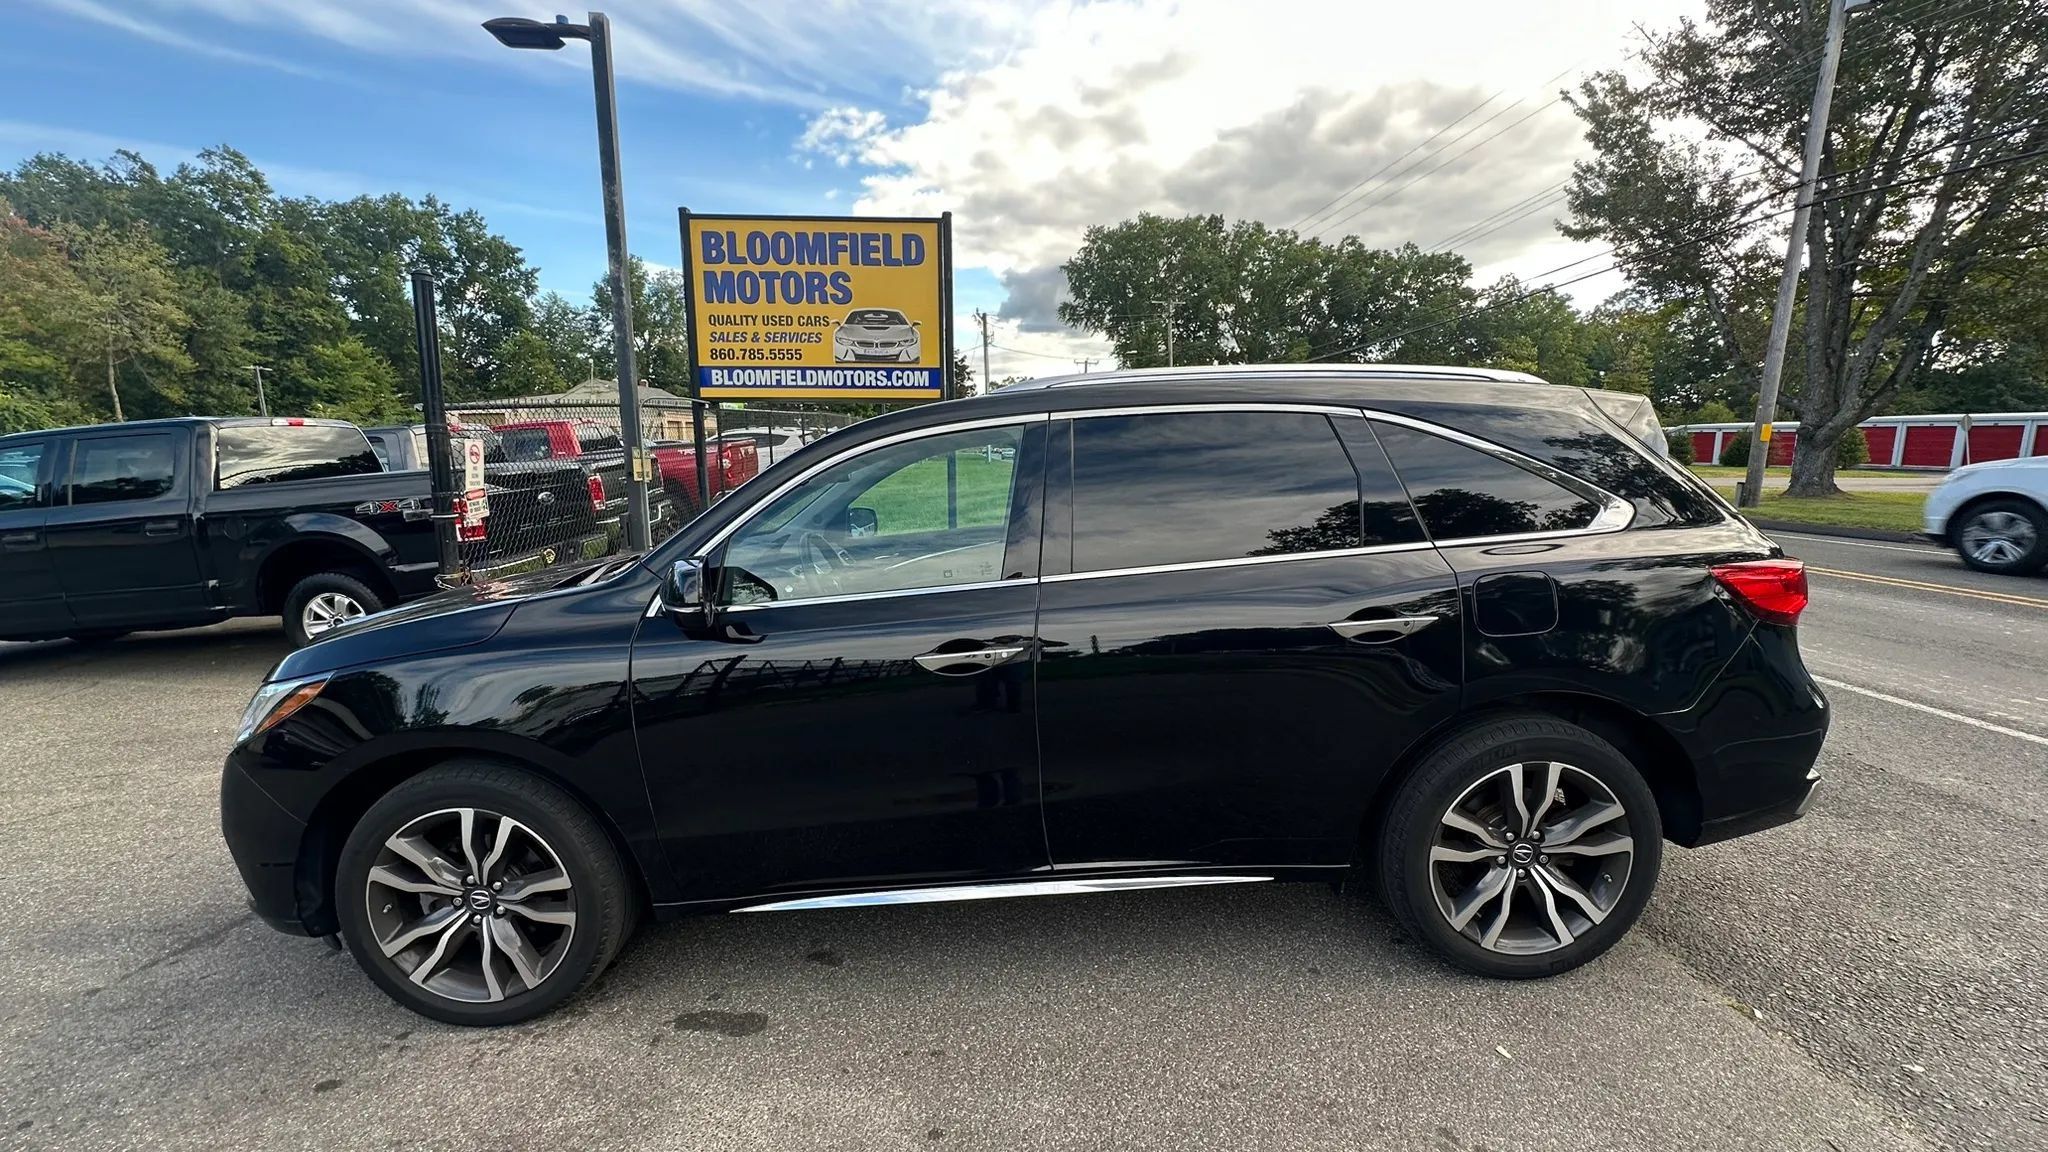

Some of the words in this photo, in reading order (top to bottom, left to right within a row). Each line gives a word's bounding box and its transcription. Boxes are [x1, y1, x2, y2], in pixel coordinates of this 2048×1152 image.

[701, 230, 926, 267] BLOOMFIELD
[703, 270, 853, 305] MOTORS
[708, 314, 758, 327] QUALITY
[762, 315, 794, 327] USED
[797, 315, 830, 328] CARS
[709, 331, 748, 343] SALES
[750, 331, 761, 343] &
[763, 331, 823, 344] SERVICES
[709, 348, 803, 361] 860.785.5555
[711, 369, 930, 387] BLOOMFIELDMOTORS.COM
